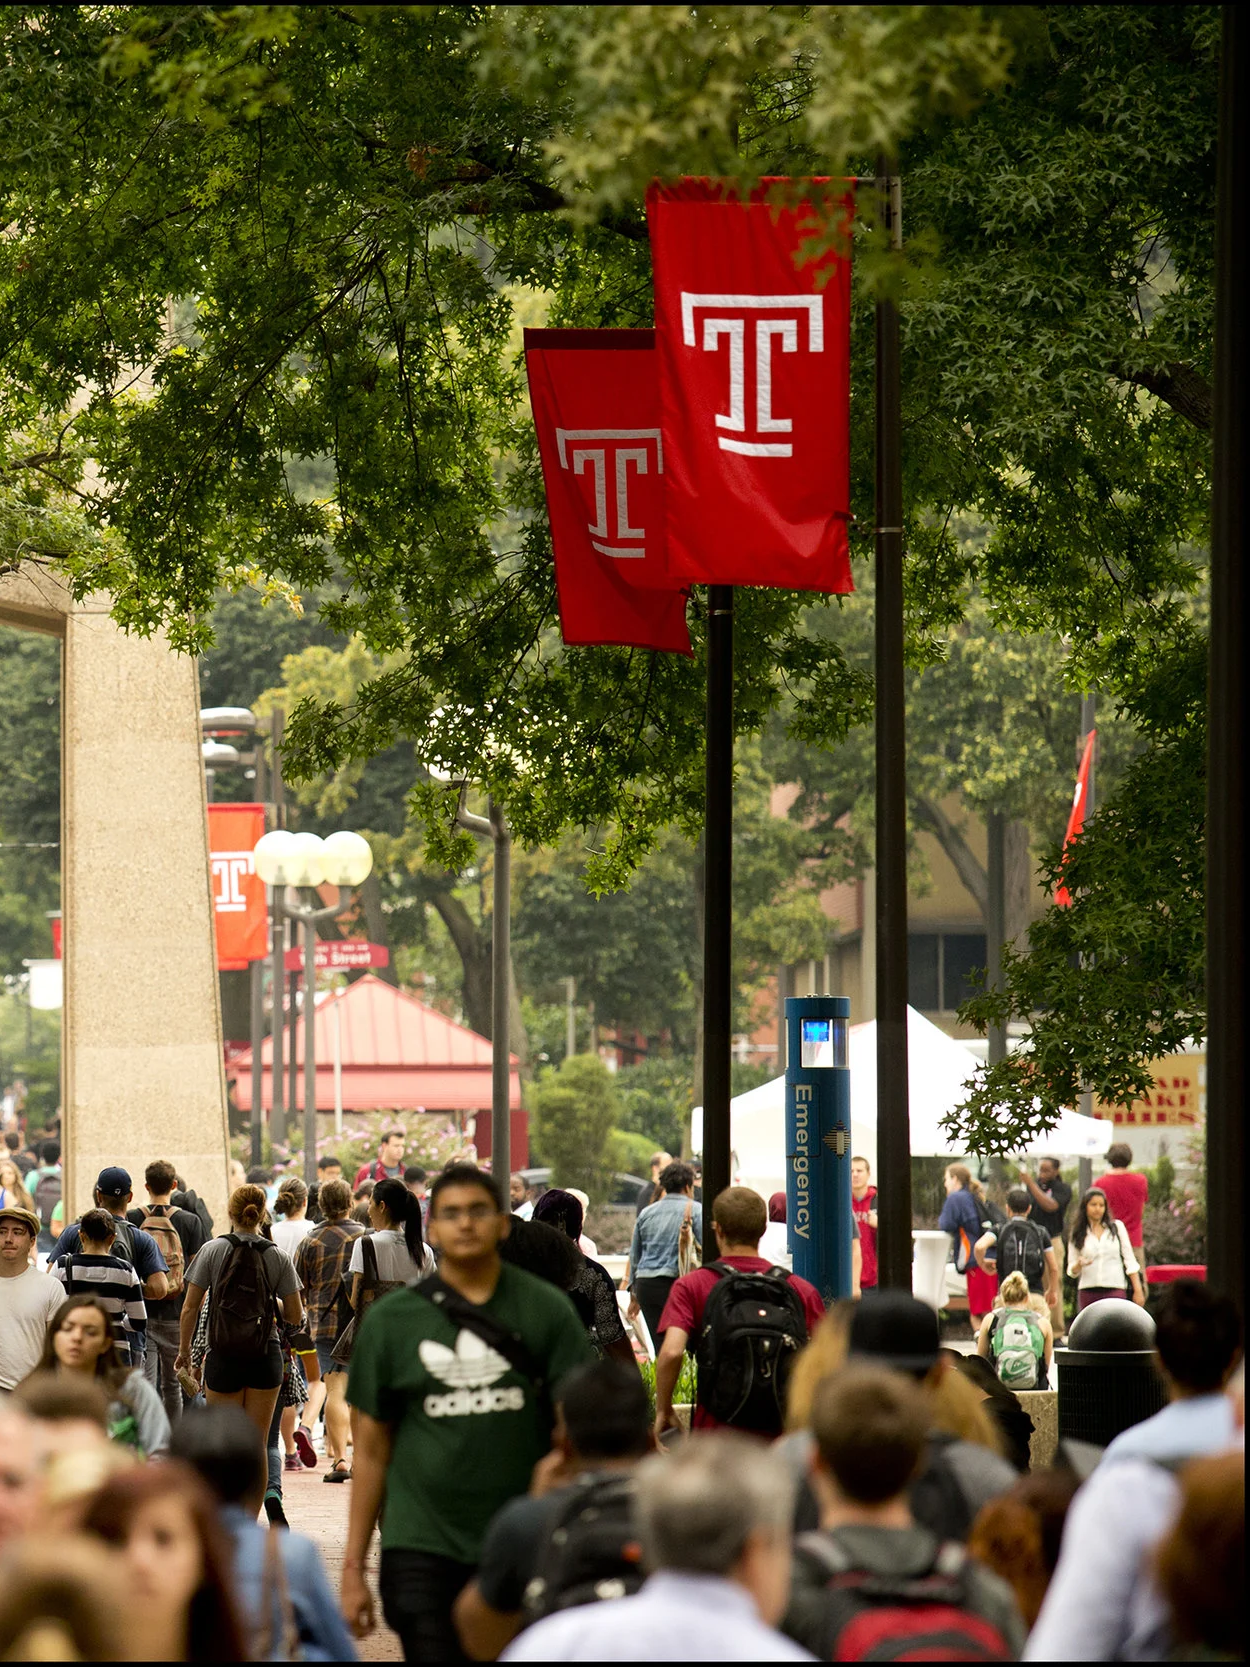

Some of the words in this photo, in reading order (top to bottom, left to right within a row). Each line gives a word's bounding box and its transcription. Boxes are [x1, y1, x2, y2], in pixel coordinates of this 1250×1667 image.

[331, 951, 371, 965] Street
[793, 1084, 812, 1240] Emergency
[423, 1387, 524, 1417] adidas
